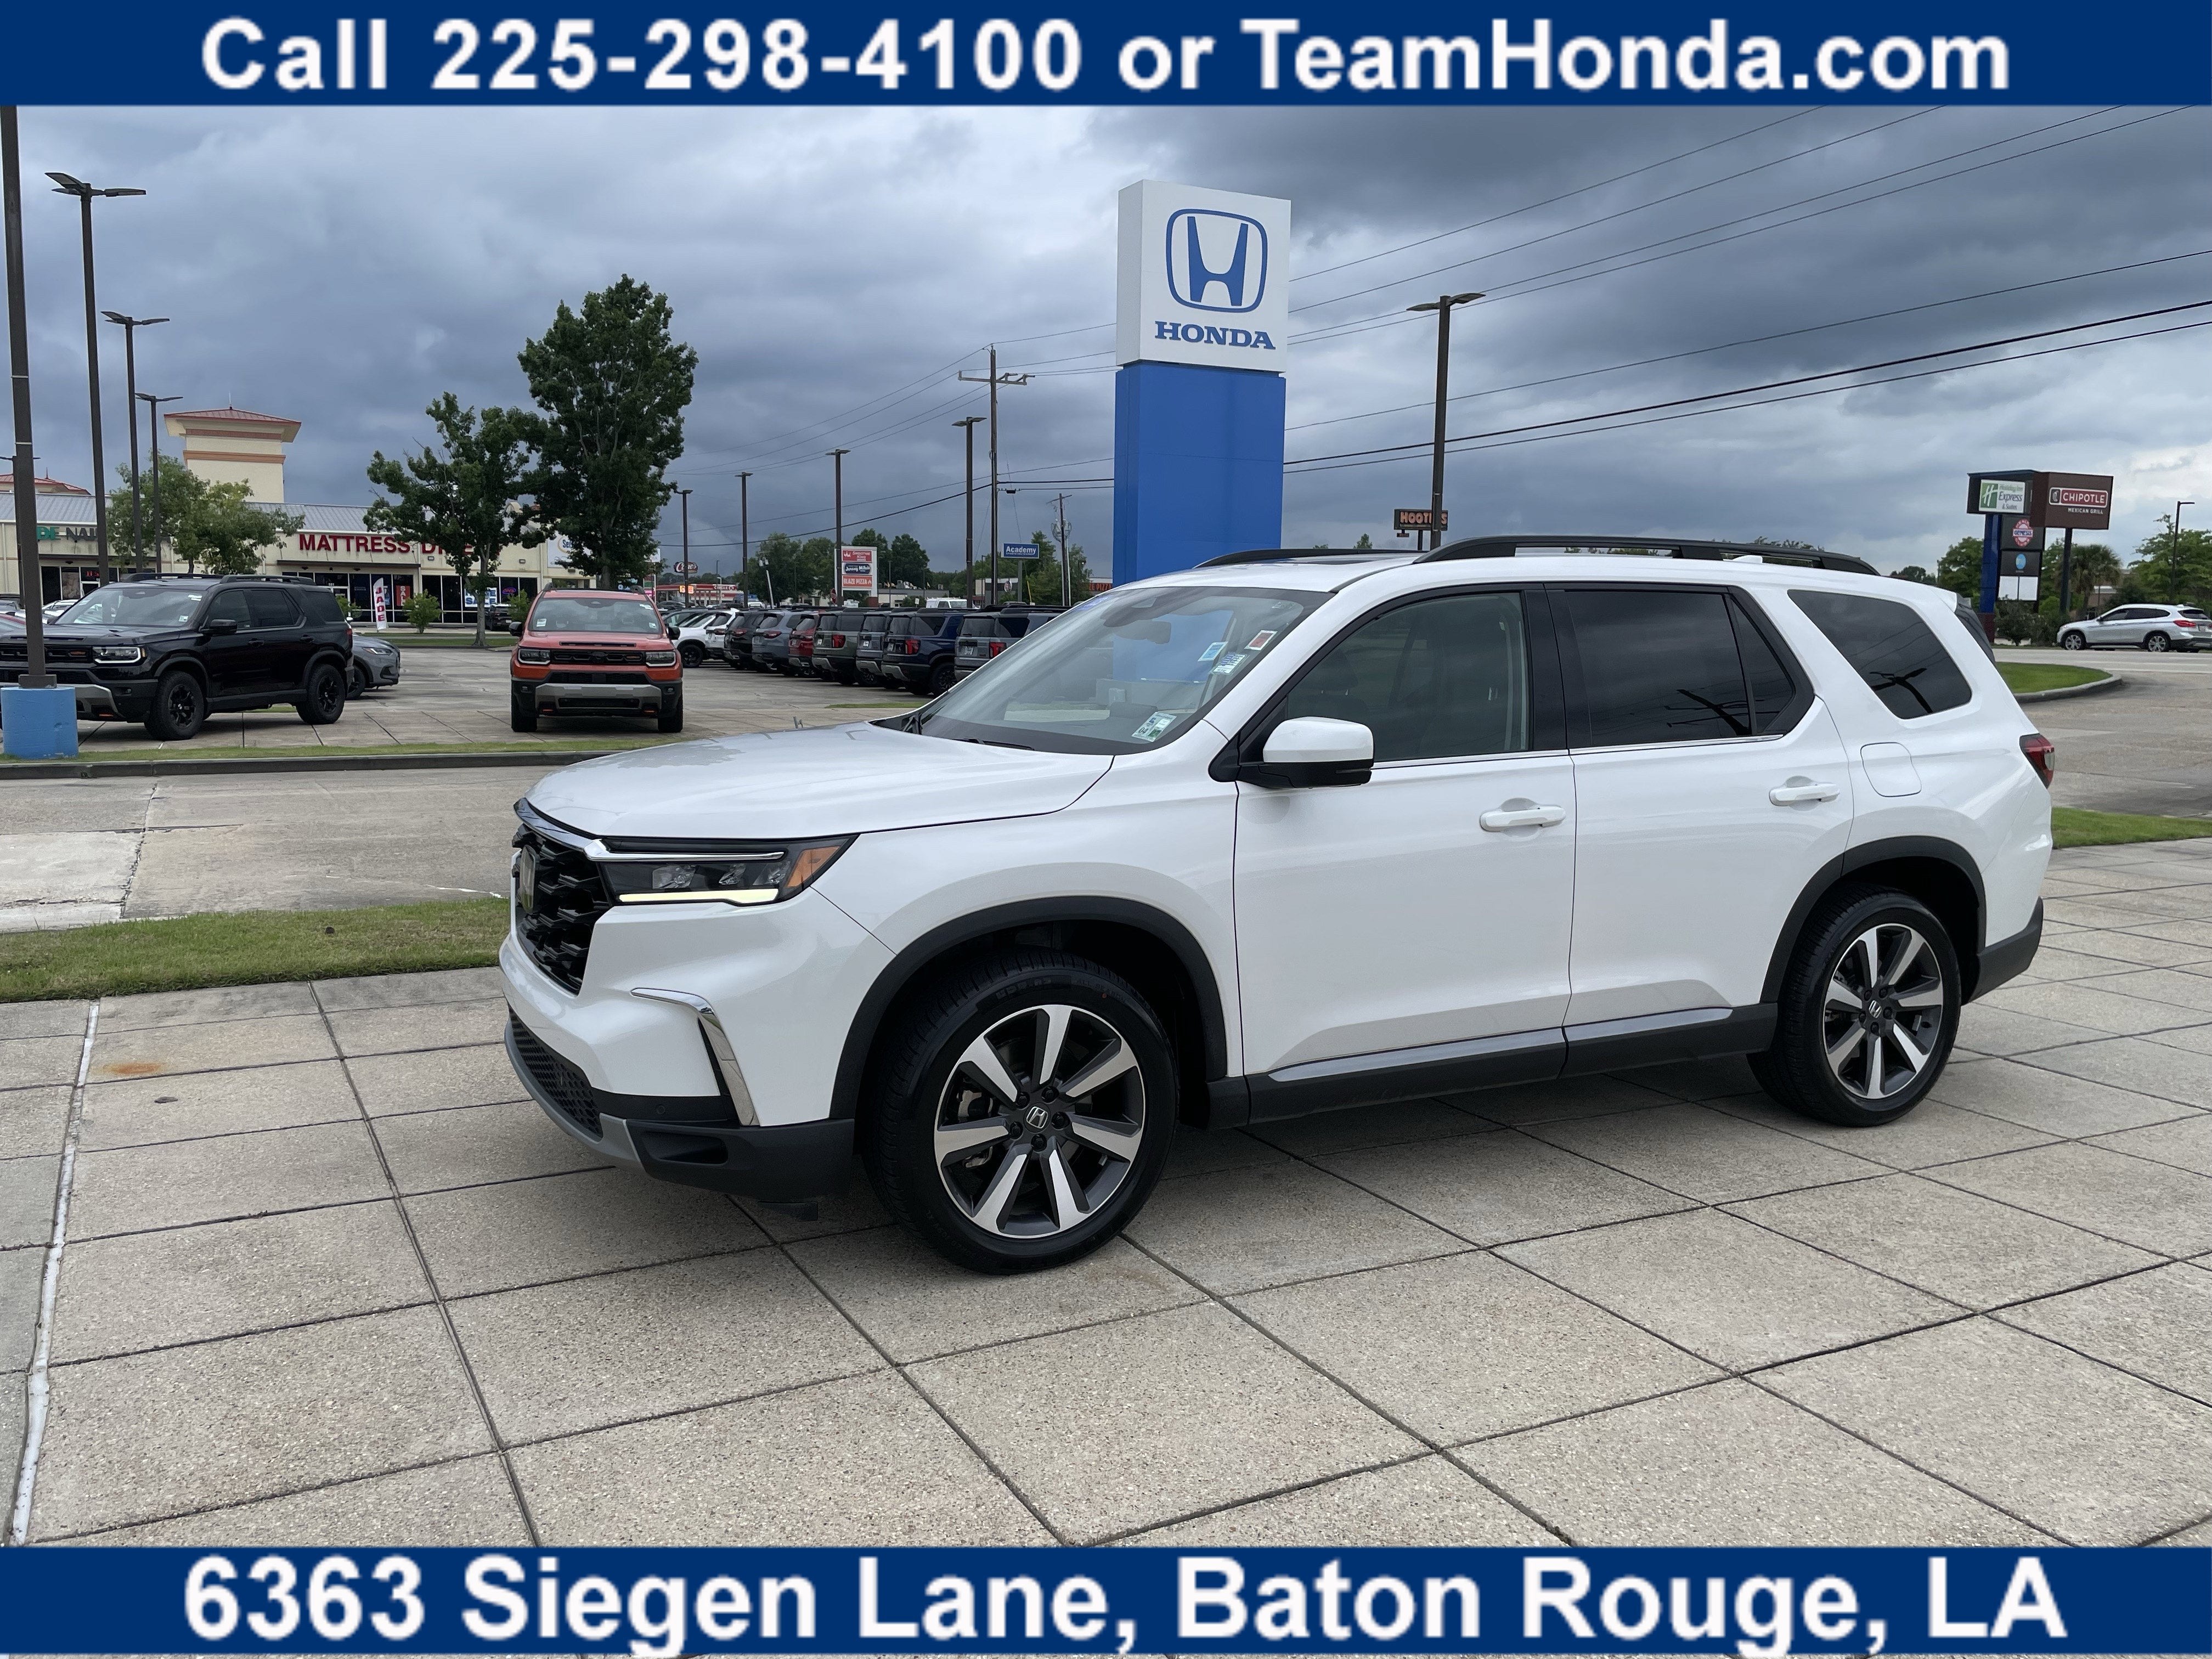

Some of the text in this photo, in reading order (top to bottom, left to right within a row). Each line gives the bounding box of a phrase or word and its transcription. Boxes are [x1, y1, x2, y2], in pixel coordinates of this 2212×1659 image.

[1155, 321, 1276, 350] HONDA
[1999, 491, 2023, 503] Express
[2063, 492, 2105, 503] CHIPOTLE
[299, 534, 410, 553] MATTRESS
[1006, 546, 1036, 555] Academy
[376, 587, 385, 622] JADE
